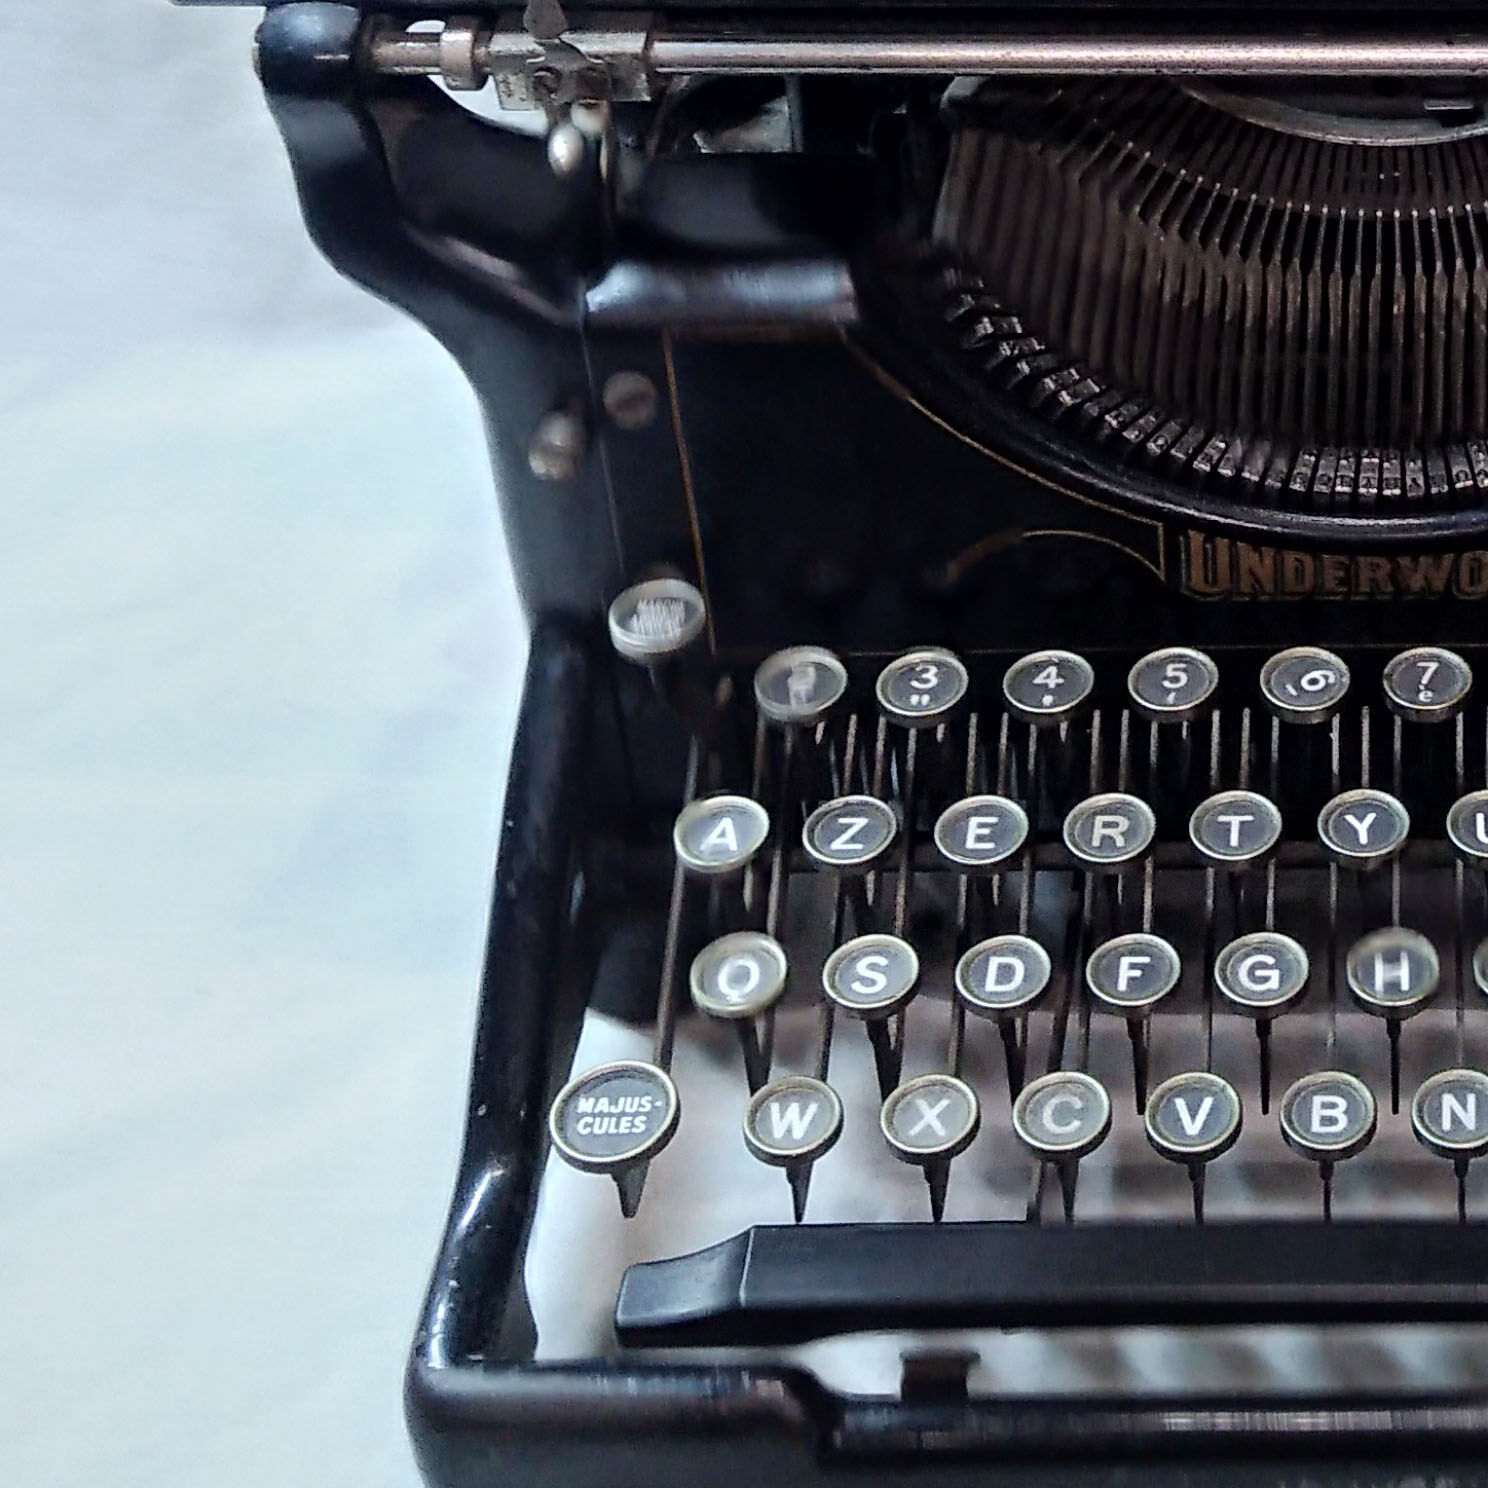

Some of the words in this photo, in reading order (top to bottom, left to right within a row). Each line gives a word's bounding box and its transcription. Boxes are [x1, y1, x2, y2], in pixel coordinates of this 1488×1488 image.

[910, 664, 939, 690] 3
[1032, 665, 1065, 690] 4
[1162, 663, 1188, 689] 5
[1416, 661, 1439, 685] 7
[703, 816, 739, 853] A
[829, 817, 869, 851] Z
[965, 816, 999, 850] E
[1091, 815, 1130, 848] R
[1217, 815, 1254, 847] T
[1344, 812, 1377, 845] Y
[850, 955, 889, 995] S
[984, 956, 1025, 993] D
[1117, 956, 1151, 993] F
[1238, 954, 1280, 992] G
[1374, 952, 1410, 993] H
[576, 1095, 664, 1114] MAJUS-
[770, 1102, 819, 1141] W
[908, 1098, 951, 1138] X
[1041, 1094, 1083, 1135] C
[1174, 1096, 1214, 1137] V
[1310, 1095, 1348, 1134] B
[1441, 1093, 1476, 1132] N
[576, 1114, 649, 1136] CULES
